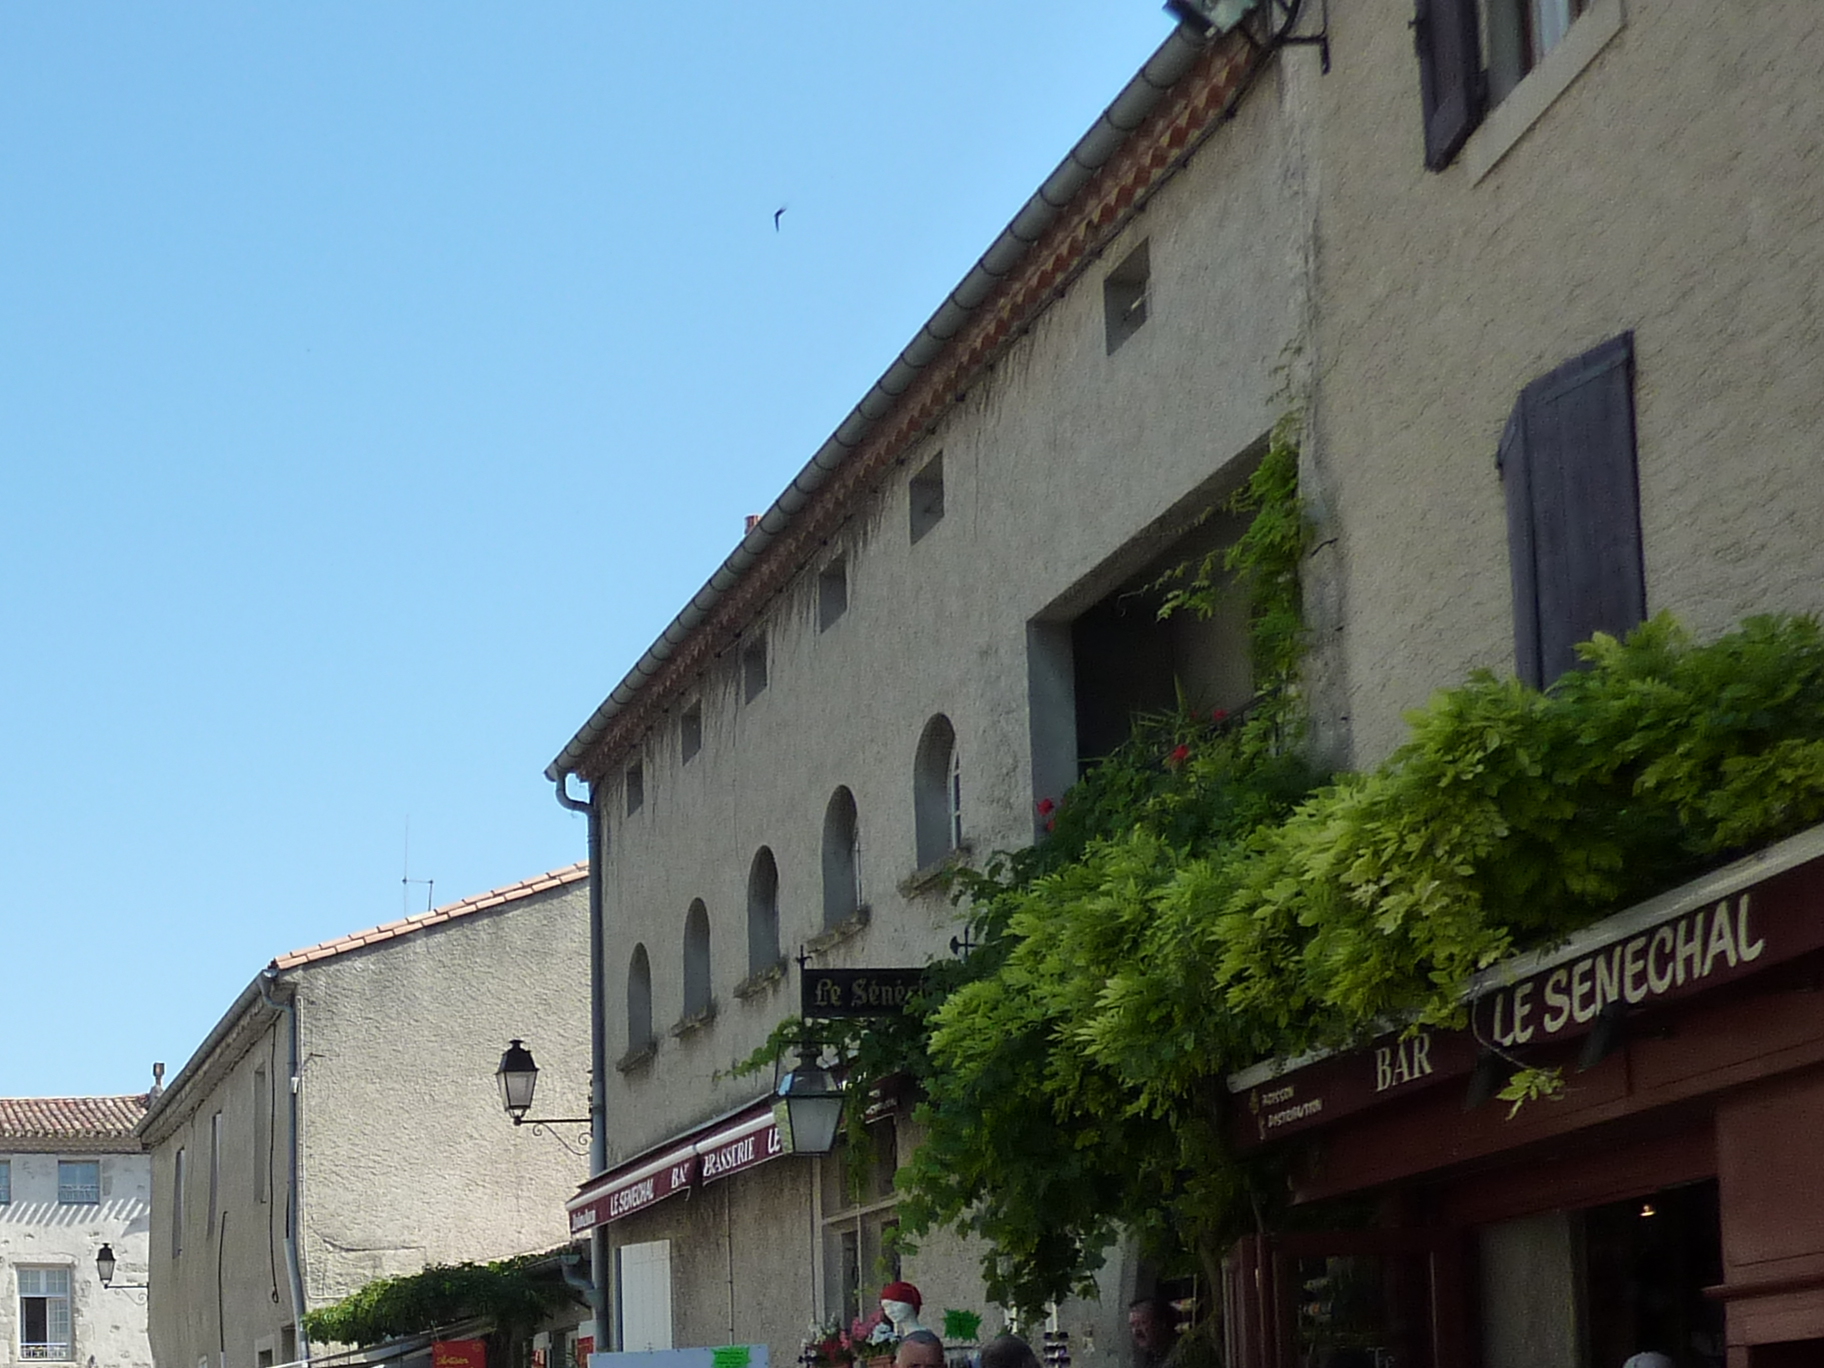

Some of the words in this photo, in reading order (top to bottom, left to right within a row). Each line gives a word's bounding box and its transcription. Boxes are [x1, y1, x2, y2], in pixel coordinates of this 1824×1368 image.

[1492, 983, 1536, 1047] LE
[1543, 892, 1766, 1034] SENECHAL
[815, 978, 842, 1007] Le
[1374, 1032, 1434, 1093] BAR
[703, 1137, 756, 1176] BRASSERIE
[619, 1178, 655, 1213] SENECHAL
